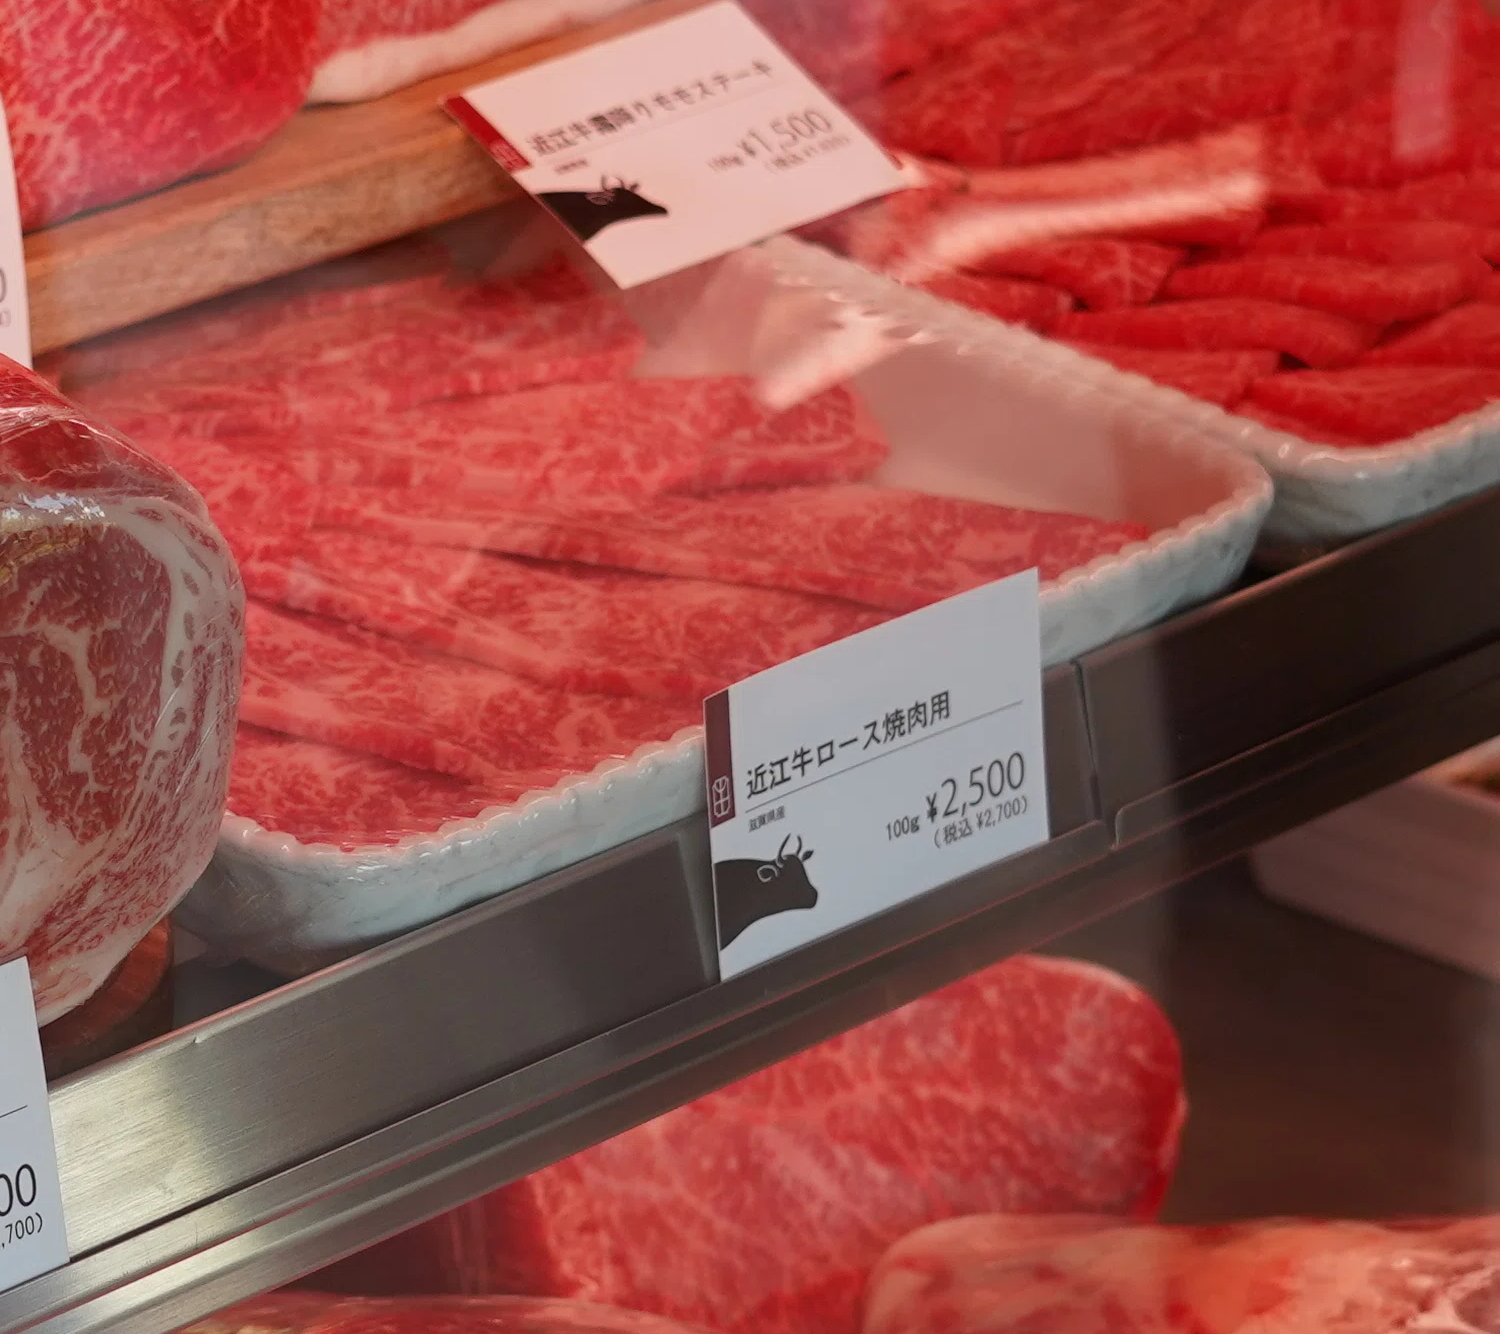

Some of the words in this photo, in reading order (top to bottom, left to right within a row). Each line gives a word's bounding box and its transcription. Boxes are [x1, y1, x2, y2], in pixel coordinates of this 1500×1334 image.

[739, 107, 833, 161] ¥1,500
[746, 689, 950, 798] 近江牛ロース焼肉用
[886, 816, 920, 841] 100g
[926, 752, 1025, 823] ¥2,500
[976, 795, 1028, 830] ¥2,700)
